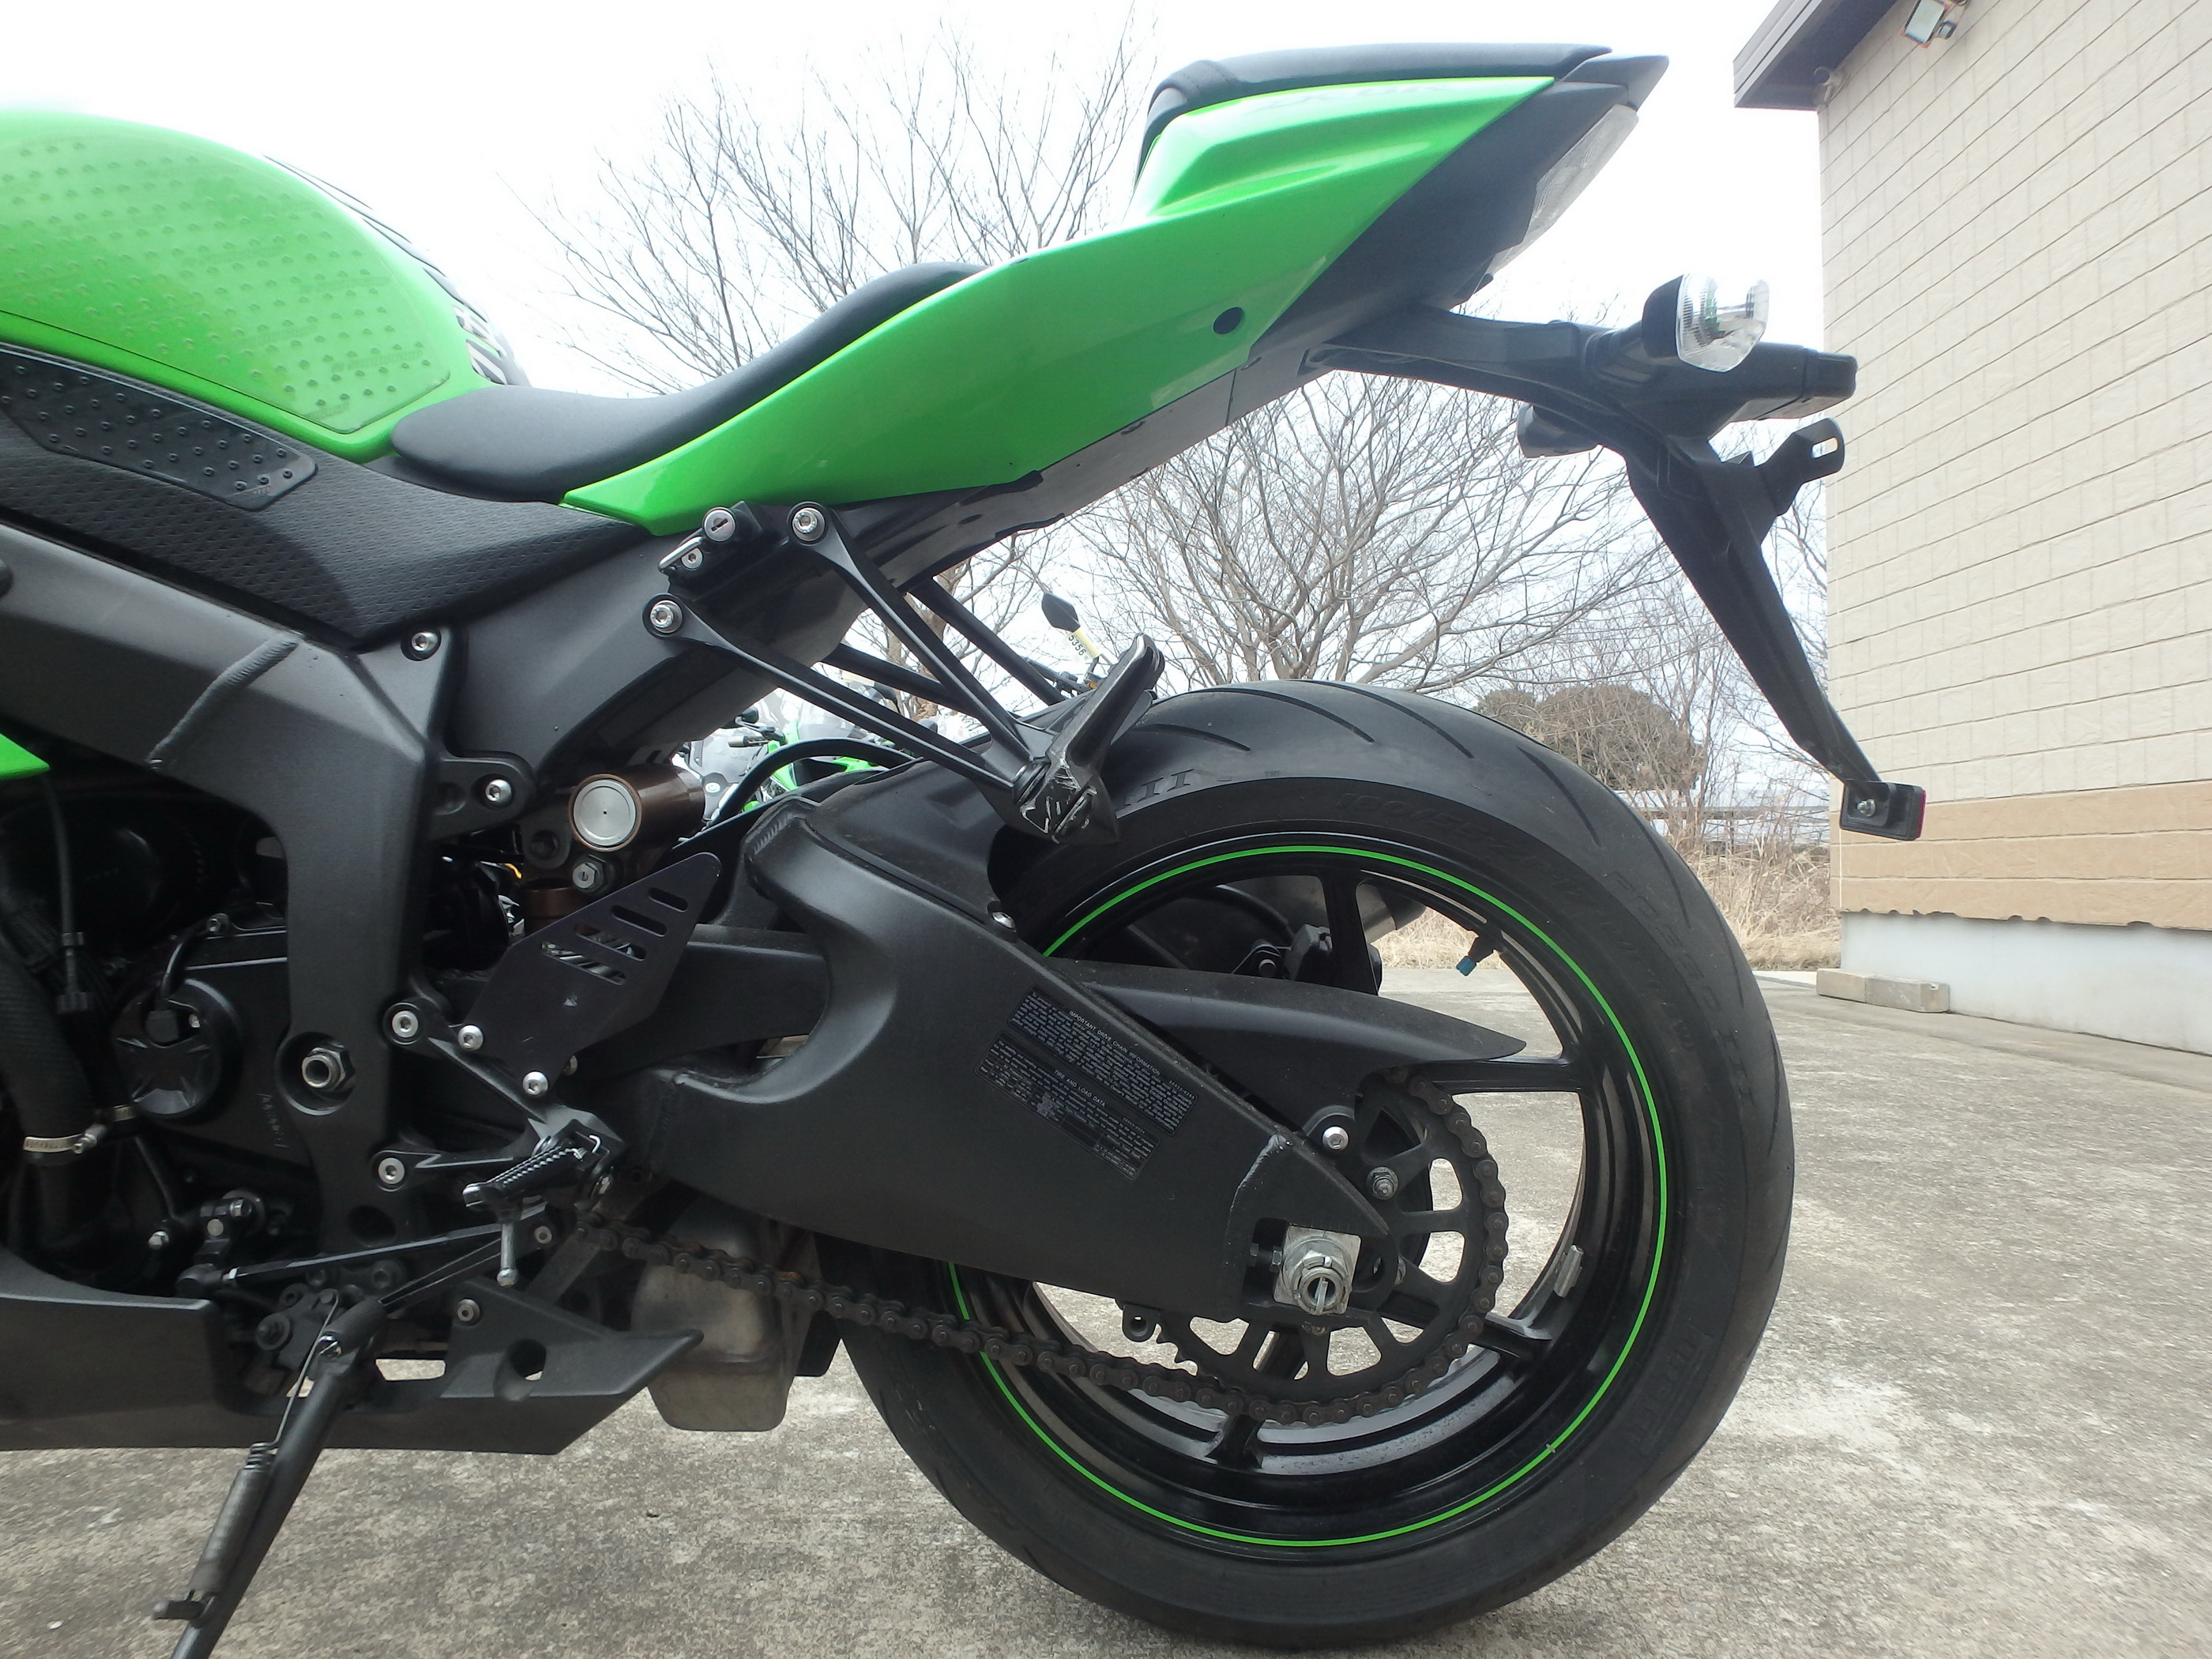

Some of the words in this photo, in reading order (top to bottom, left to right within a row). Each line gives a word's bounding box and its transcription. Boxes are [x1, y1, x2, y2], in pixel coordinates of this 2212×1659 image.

[1068, 635, 1086, 656] 5356
[1068, 1010, 1096, 1031] IMPORTANT
[1097, 1029, 1112, 1042] DRIVE
[1112, 1040, 1128, 1053] CHAIN
[1127, 1051, 1161, 1075] INFORMATION
[1053, 1069, 1065, 1079] TIRE
[1065, 1077, 1078, 1087] AND
[1077, 1085, 1092, 1097] LOAD
[1092, 1095, 1106, 1107] DATA
